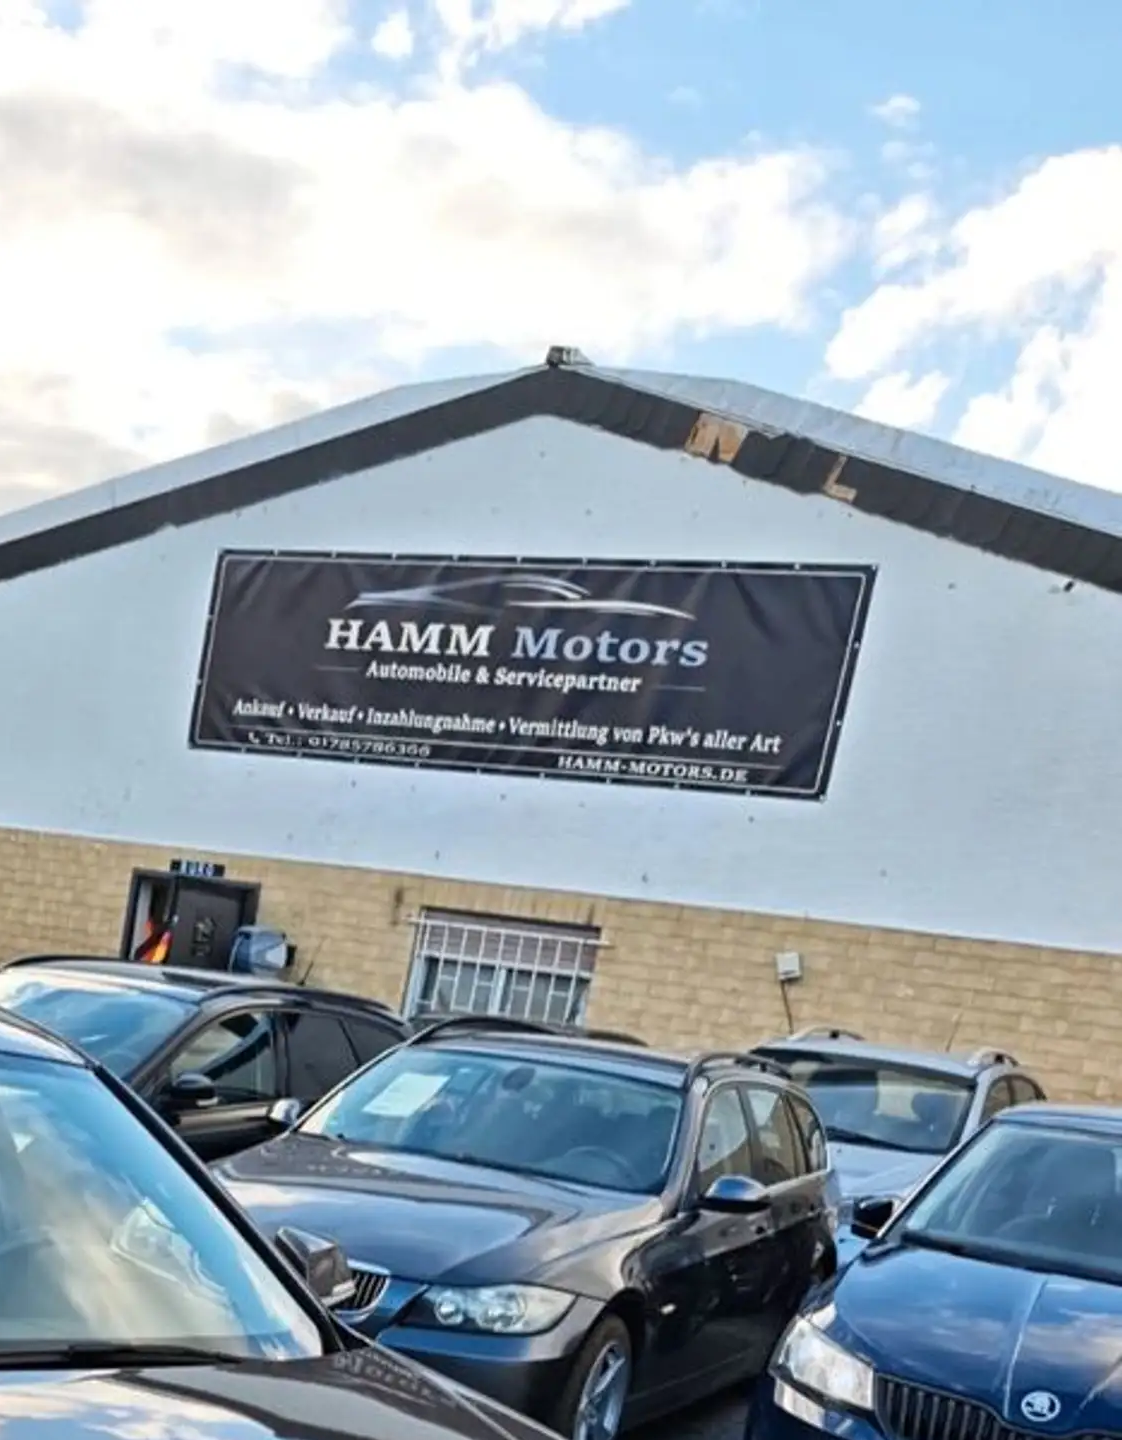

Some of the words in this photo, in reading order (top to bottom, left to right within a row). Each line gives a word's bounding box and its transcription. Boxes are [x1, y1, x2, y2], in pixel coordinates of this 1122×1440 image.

[325, 618, 495, 656] HAMM
[510, 626, 709, 667] Motors
[365, 660, 471, 684] Automobile
[474, 666, 490, 685] &
[493, 666, 643, 694] Servicepartner
[232, 698, 286, 718] Ankauf
[296, 702, 358, 724] Verkauf
[365, 707, 497, 735] Inzahlungnahme
[508, 716, 610, 745] Vermittlung
[612, 727, 643, 743] von
[646, 724, 699, 747] Pkw's
[703, 729, 746, 751] aller
[749, 731, 782, 754] Art
[557, 755, 750, 783] HAMM-MOTORS.DE
